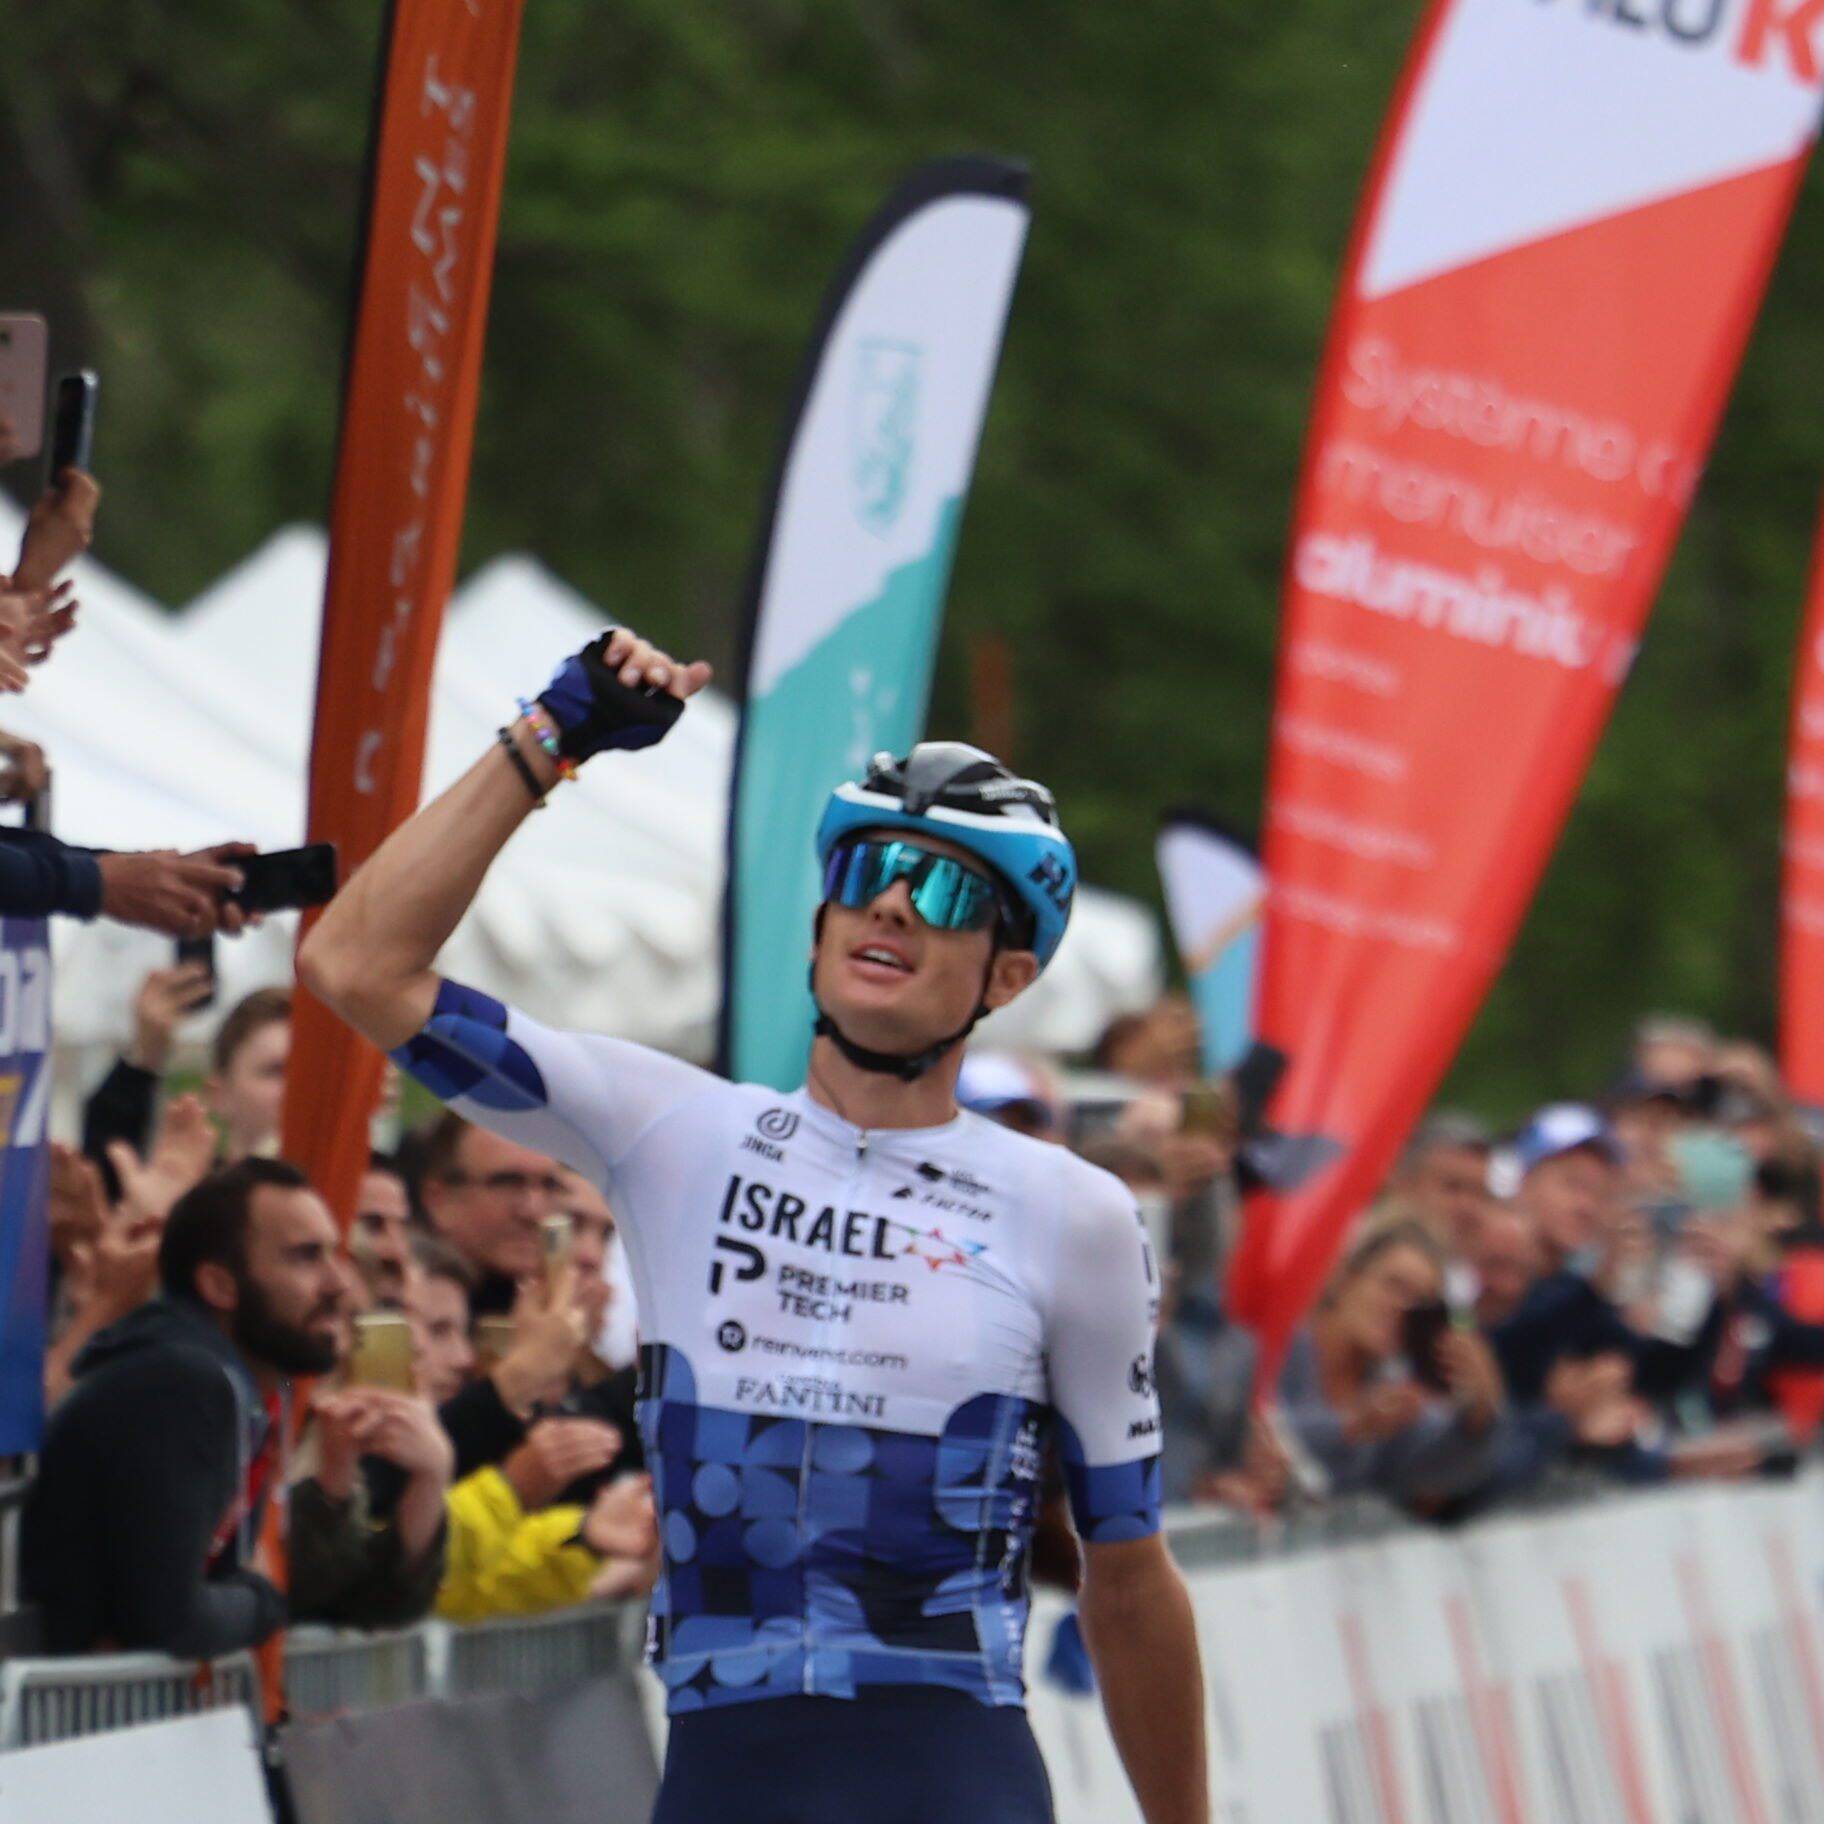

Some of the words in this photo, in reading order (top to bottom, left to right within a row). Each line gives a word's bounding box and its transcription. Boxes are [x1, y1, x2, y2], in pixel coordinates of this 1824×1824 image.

[720, 1174, 896, 1261] ISRAEL
[778, 1264, 909, 1305] PREMIER
[778, 1291, 852, 1323] TECH
[736, 1378, 887, 1417] FANTINI
